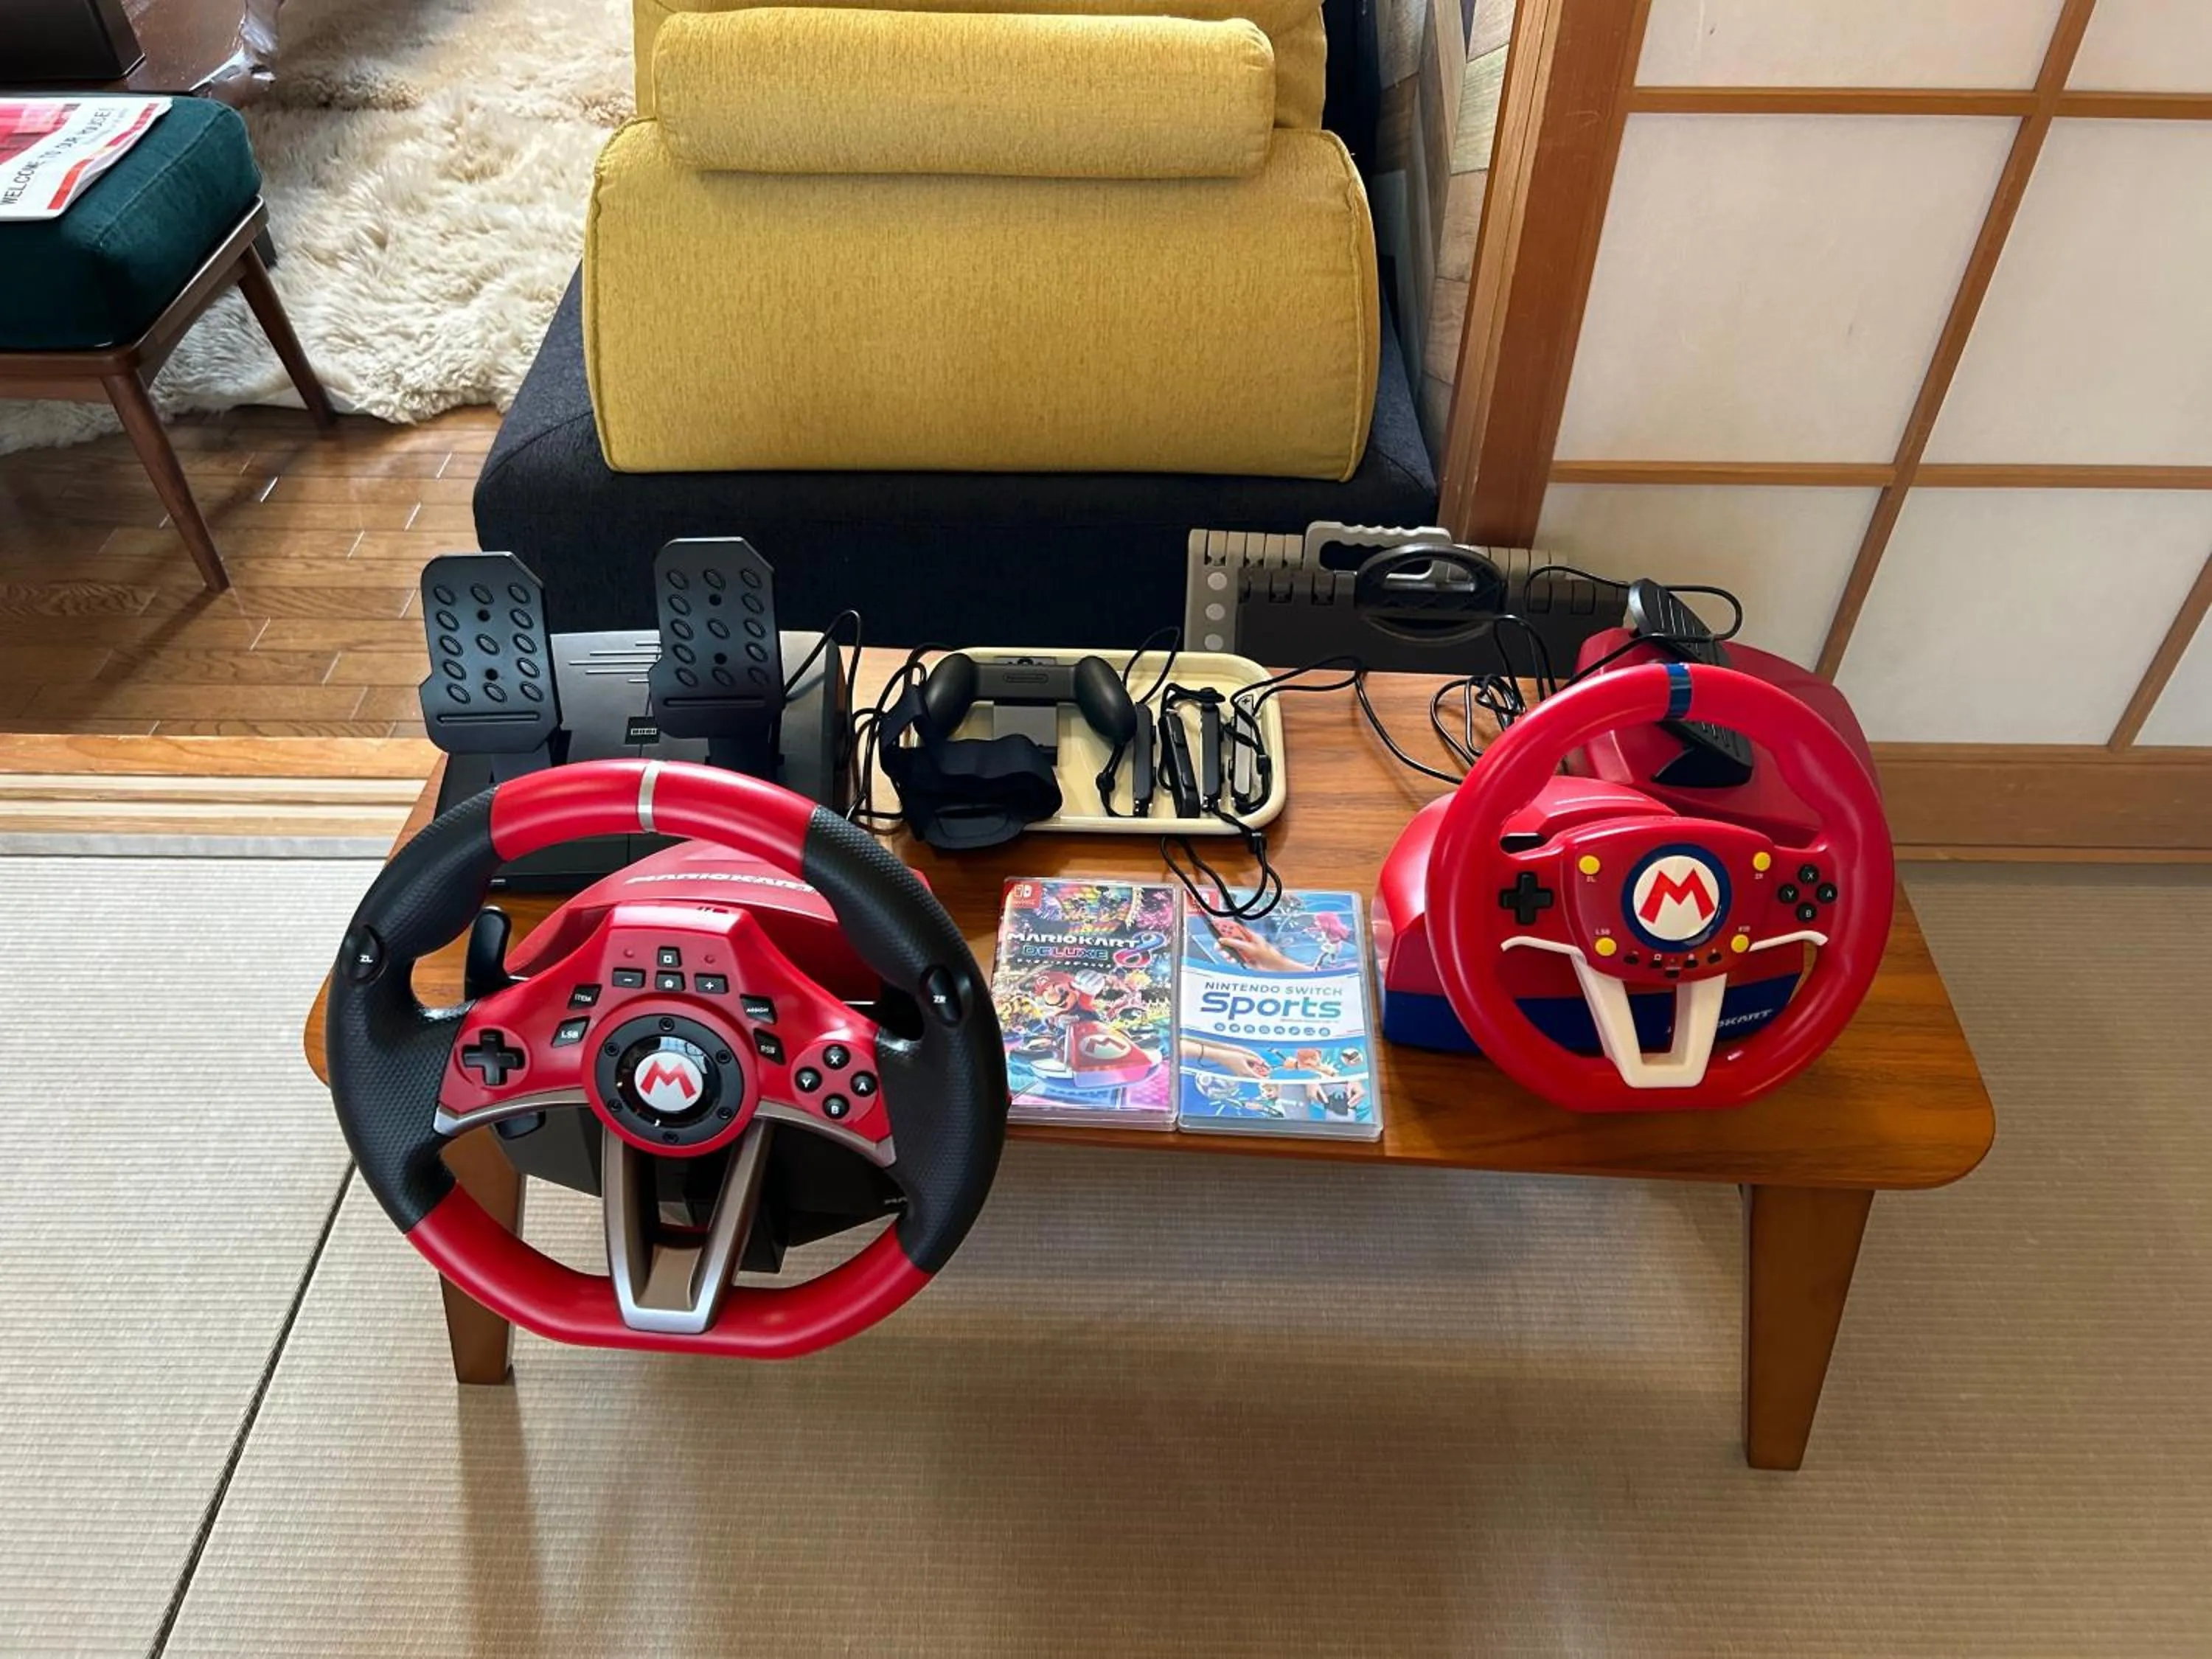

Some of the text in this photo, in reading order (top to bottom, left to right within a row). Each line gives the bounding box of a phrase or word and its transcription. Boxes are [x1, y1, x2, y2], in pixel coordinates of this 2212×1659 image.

[1787, 890, 1794, 898] Y
[1806, 909, 1812, 918] B
[1023, 945, 1108, 961] DELUXE
[1205, 981, 1343, 996] NINTENDO SWITCH
[574, 994, 591, 1002] ITEM
[1200, 992, 1342, 1020] Sports
[561, 1031, 579, 1039] LSB
[830, 1055, 839, 1065] X
[801, 1079, 812, 1089] Y
[830, 1105, 839, 1115] B
